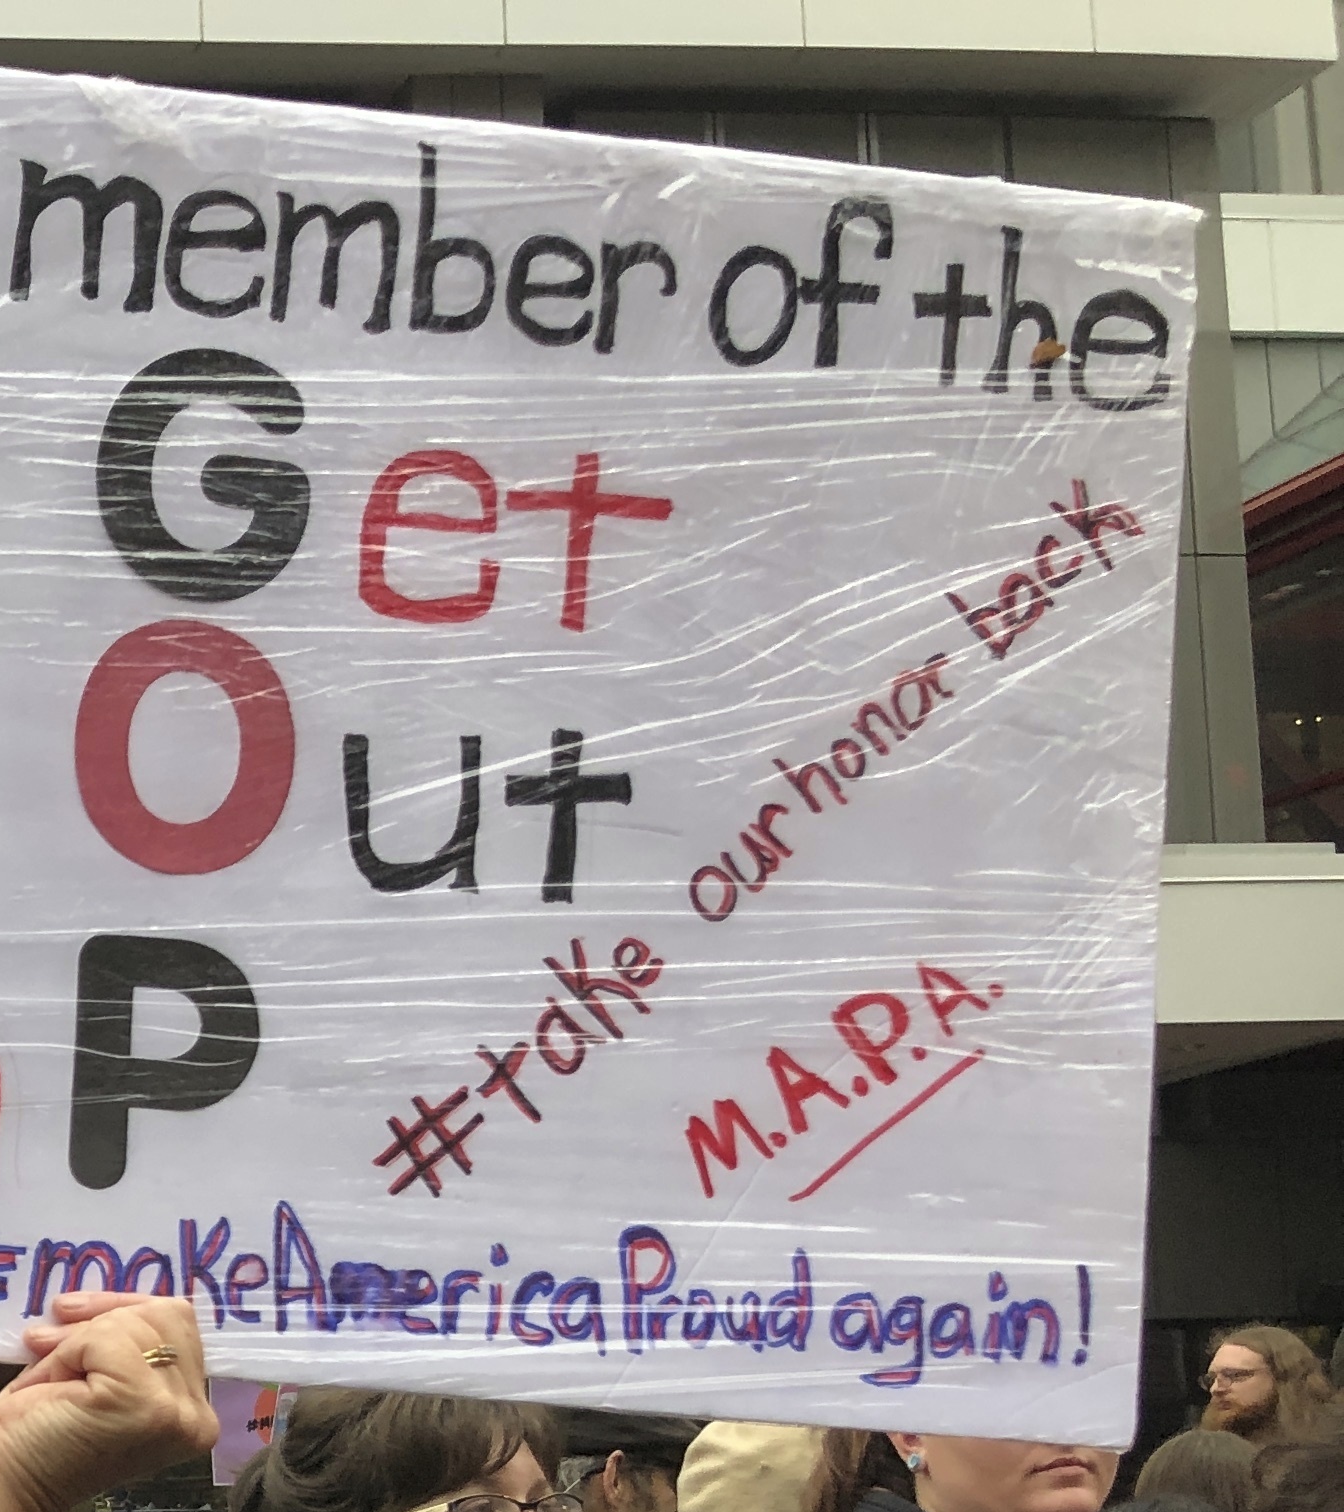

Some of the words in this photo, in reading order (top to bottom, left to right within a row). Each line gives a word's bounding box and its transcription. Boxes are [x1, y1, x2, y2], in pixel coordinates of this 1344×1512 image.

[9, 141, 679, 353] member
[711, 194, 893, 368] of
[913, 224, 1171, 413] the
[95, 346, 674, 634] Get
[74, 618, 632, 904] Out
[689, 802, 793, 923] our
[684, 961, 1005, 1200] M.A.P.A.
